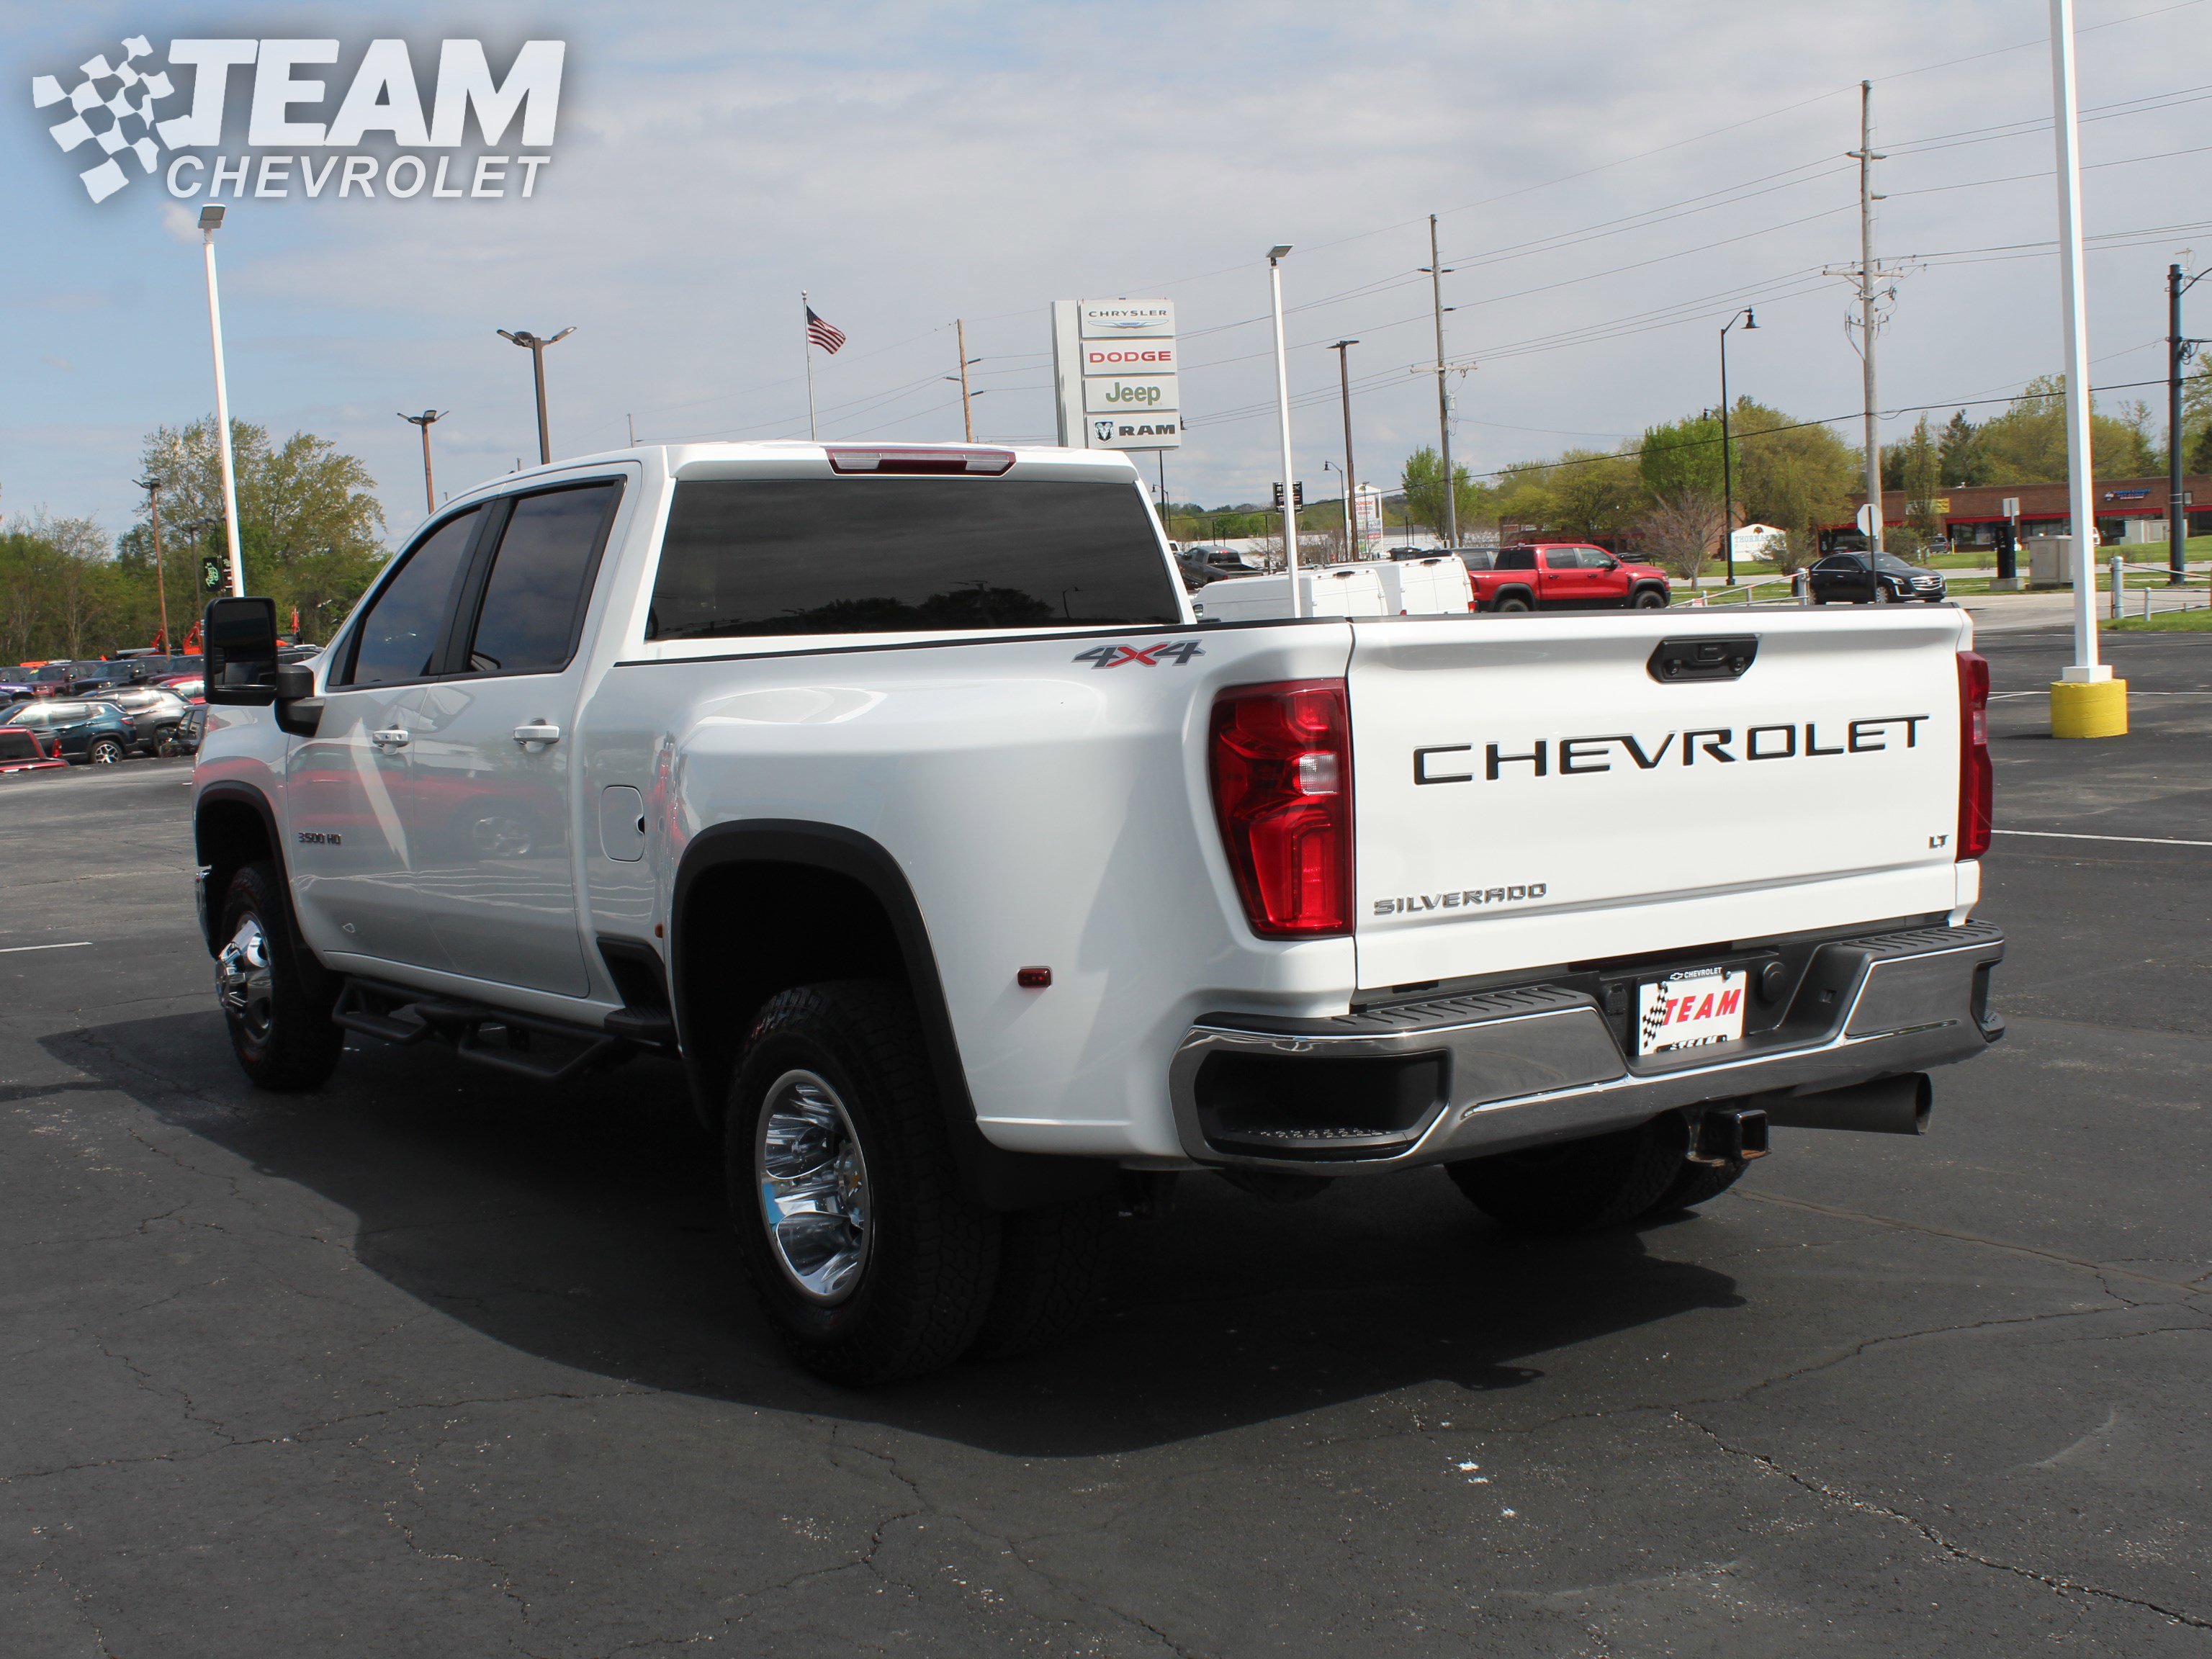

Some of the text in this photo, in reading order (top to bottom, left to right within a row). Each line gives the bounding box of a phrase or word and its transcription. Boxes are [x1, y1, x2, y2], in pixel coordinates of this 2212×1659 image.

[1089, 351, 1172, 363] DODGE
[1105, 382, 1161, 406] Jeep
[1118, 424, 1176, 436] RAM
[1413, 714, 1930, 786] CHEVROLET
[298, 832, 342, 845] 3500 HD
[1928, 833, 1950, 850] LT
[1373, 882, 1547, 915] SILVERADO
[1683, 966, 1722, 979] CHEVROLET
[1662, 989, 1741, 1026] TEAM
